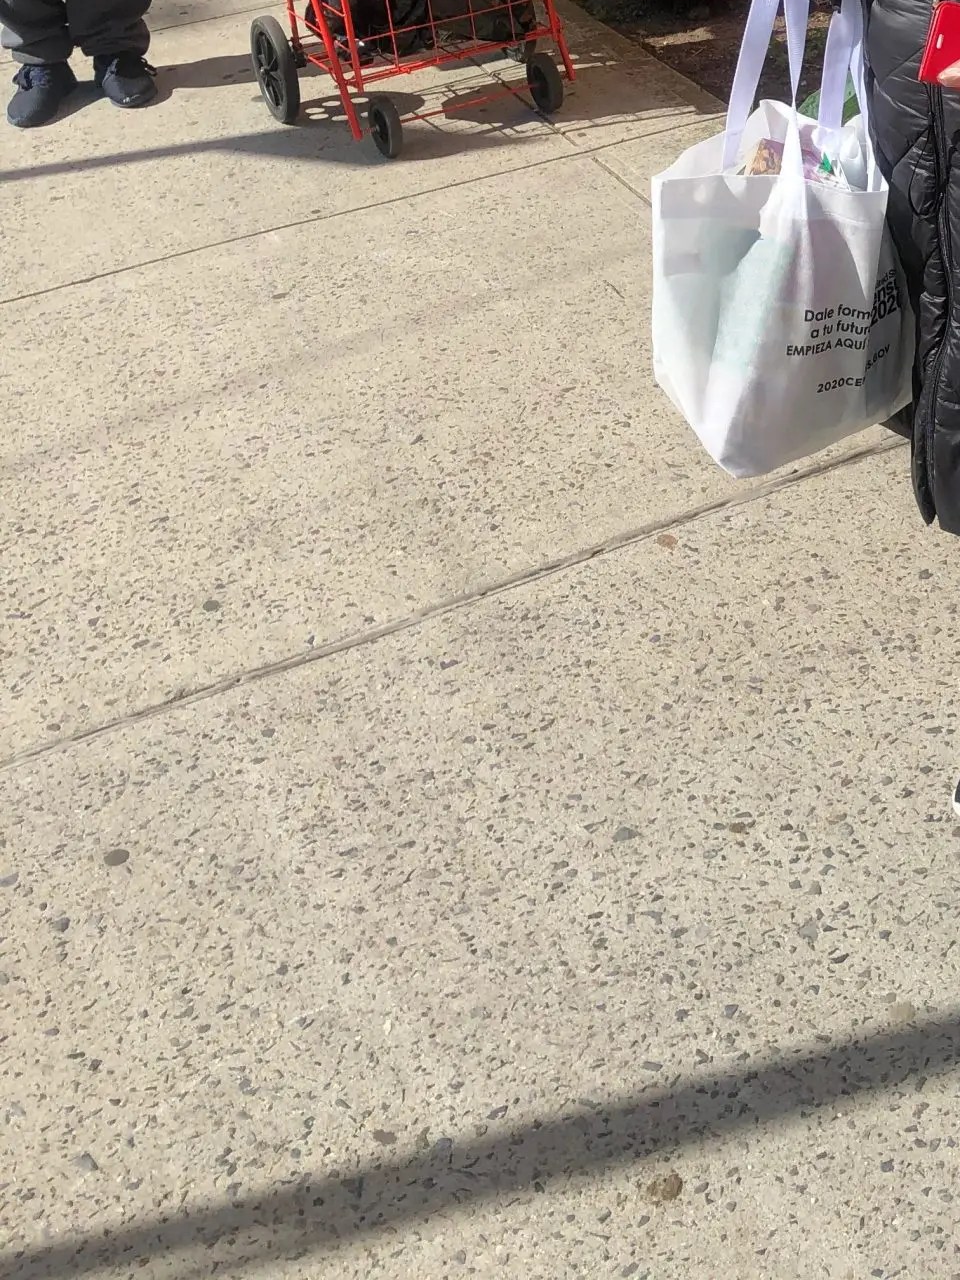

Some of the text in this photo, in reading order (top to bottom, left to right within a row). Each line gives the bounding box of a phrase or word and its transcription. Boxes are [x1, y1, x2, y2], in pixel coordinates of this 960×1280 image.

[805, 304, 870, 322] Dale form
[811, 320, 870, 339] a tu futur
[786, 341, 832, 356] EMPIEZA
[865, 344, 890, 371] S.GOV
